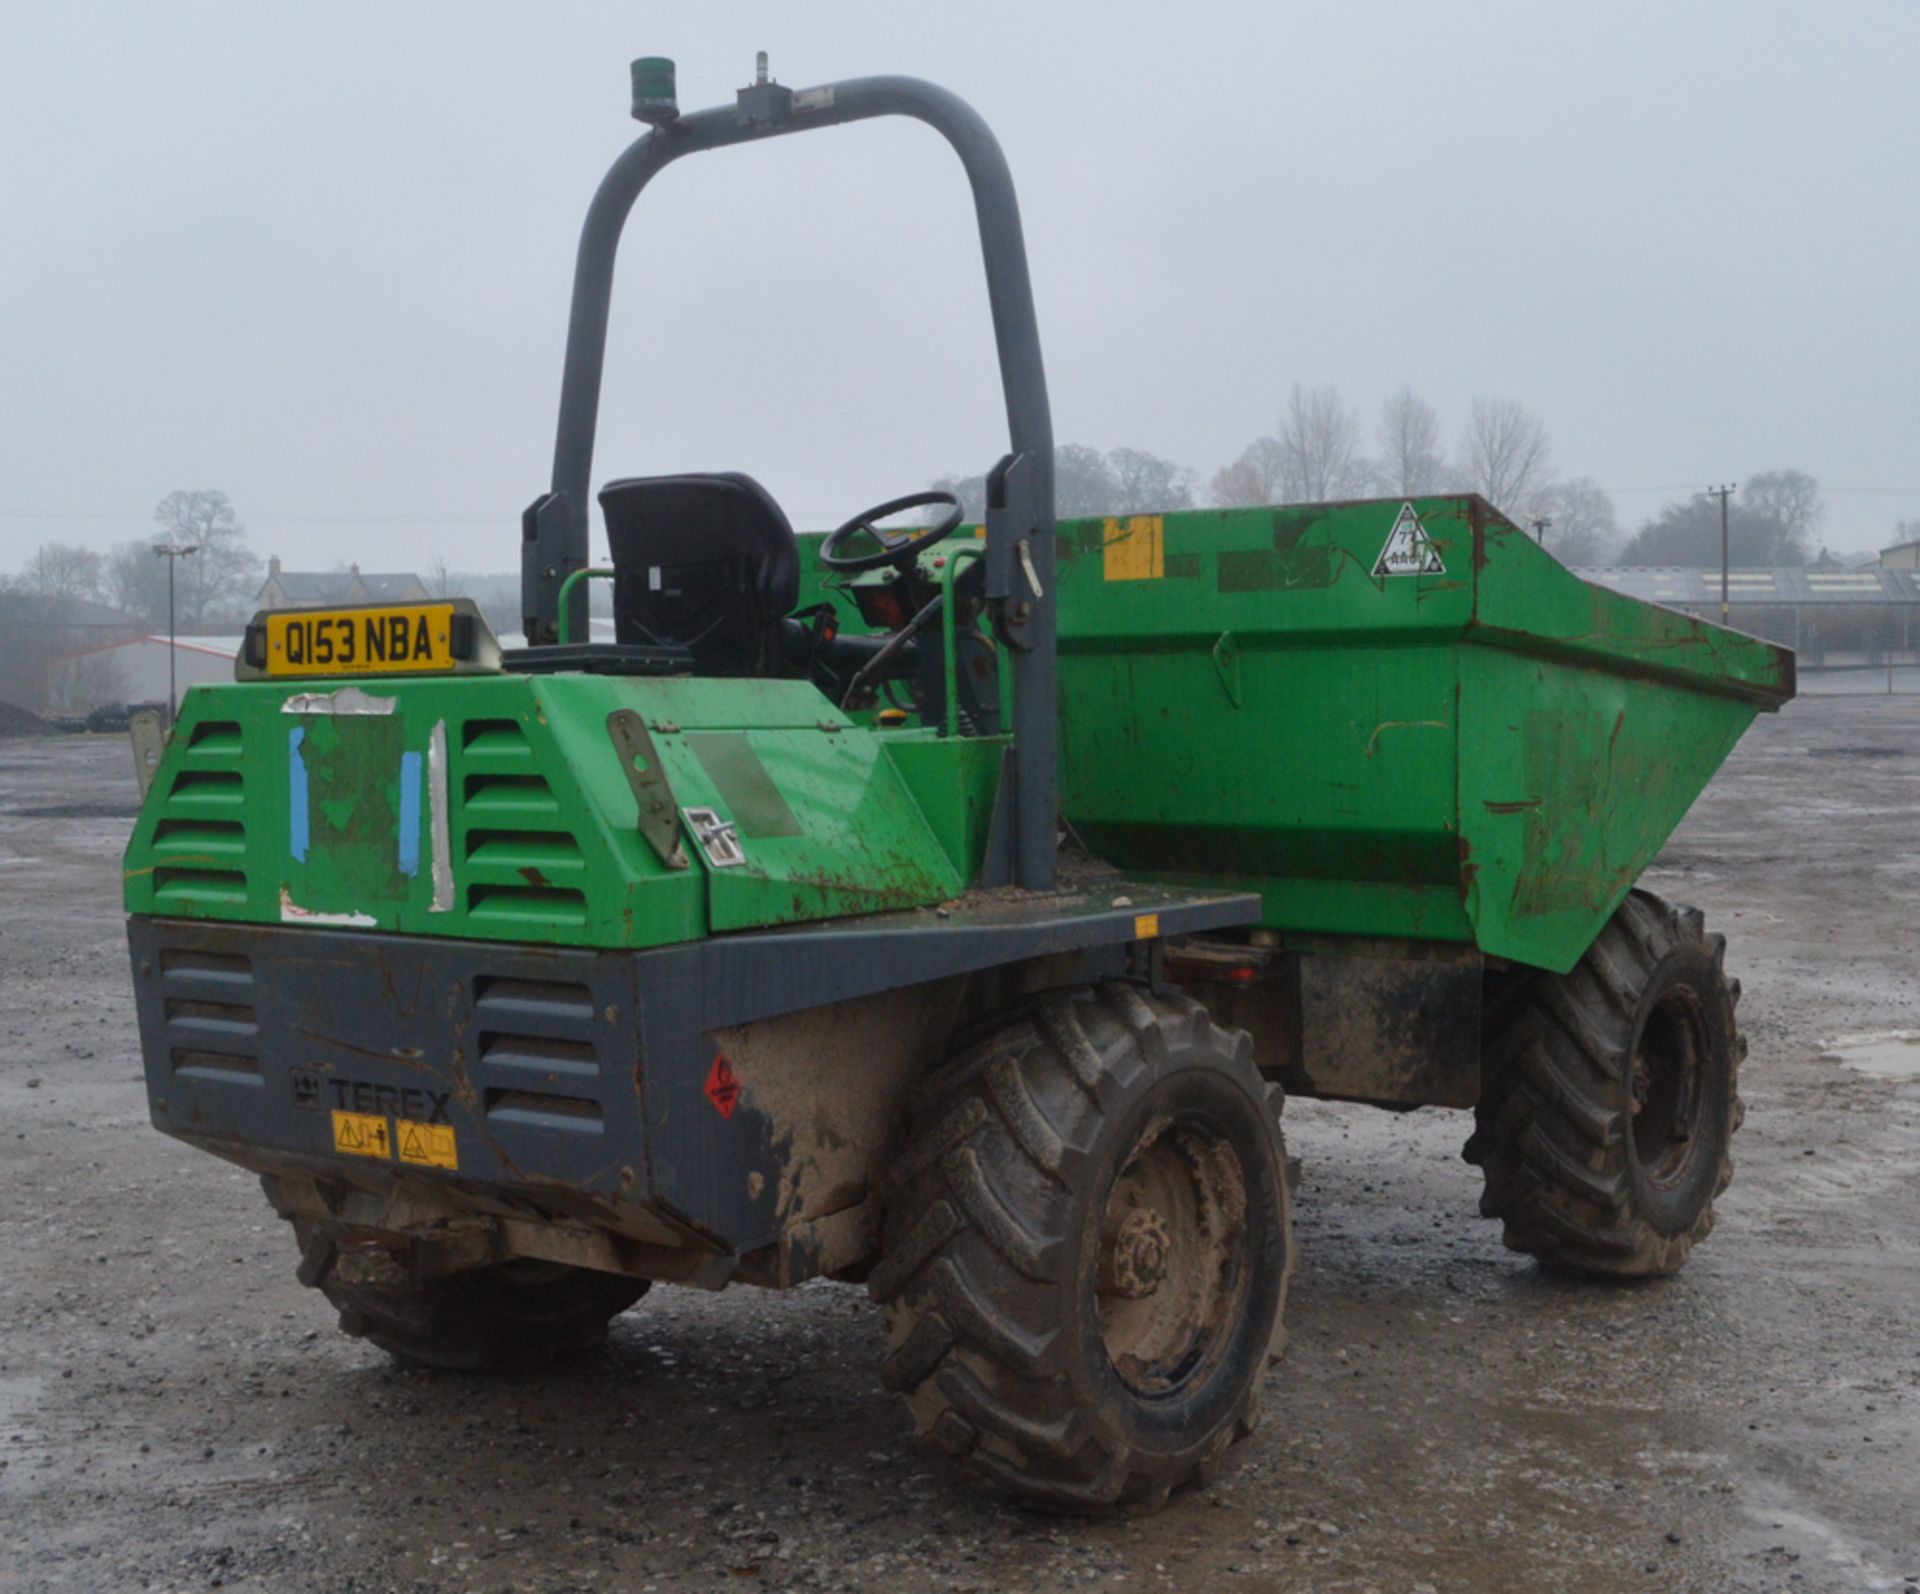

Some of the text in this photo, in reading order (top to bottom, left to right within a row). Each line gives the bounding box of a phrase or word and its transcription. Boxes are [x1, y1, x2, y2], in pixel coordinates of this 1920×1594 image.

[286, 615, 433, 665] Q153 NBA
[329, 1078, 451, 1125] TEREX
